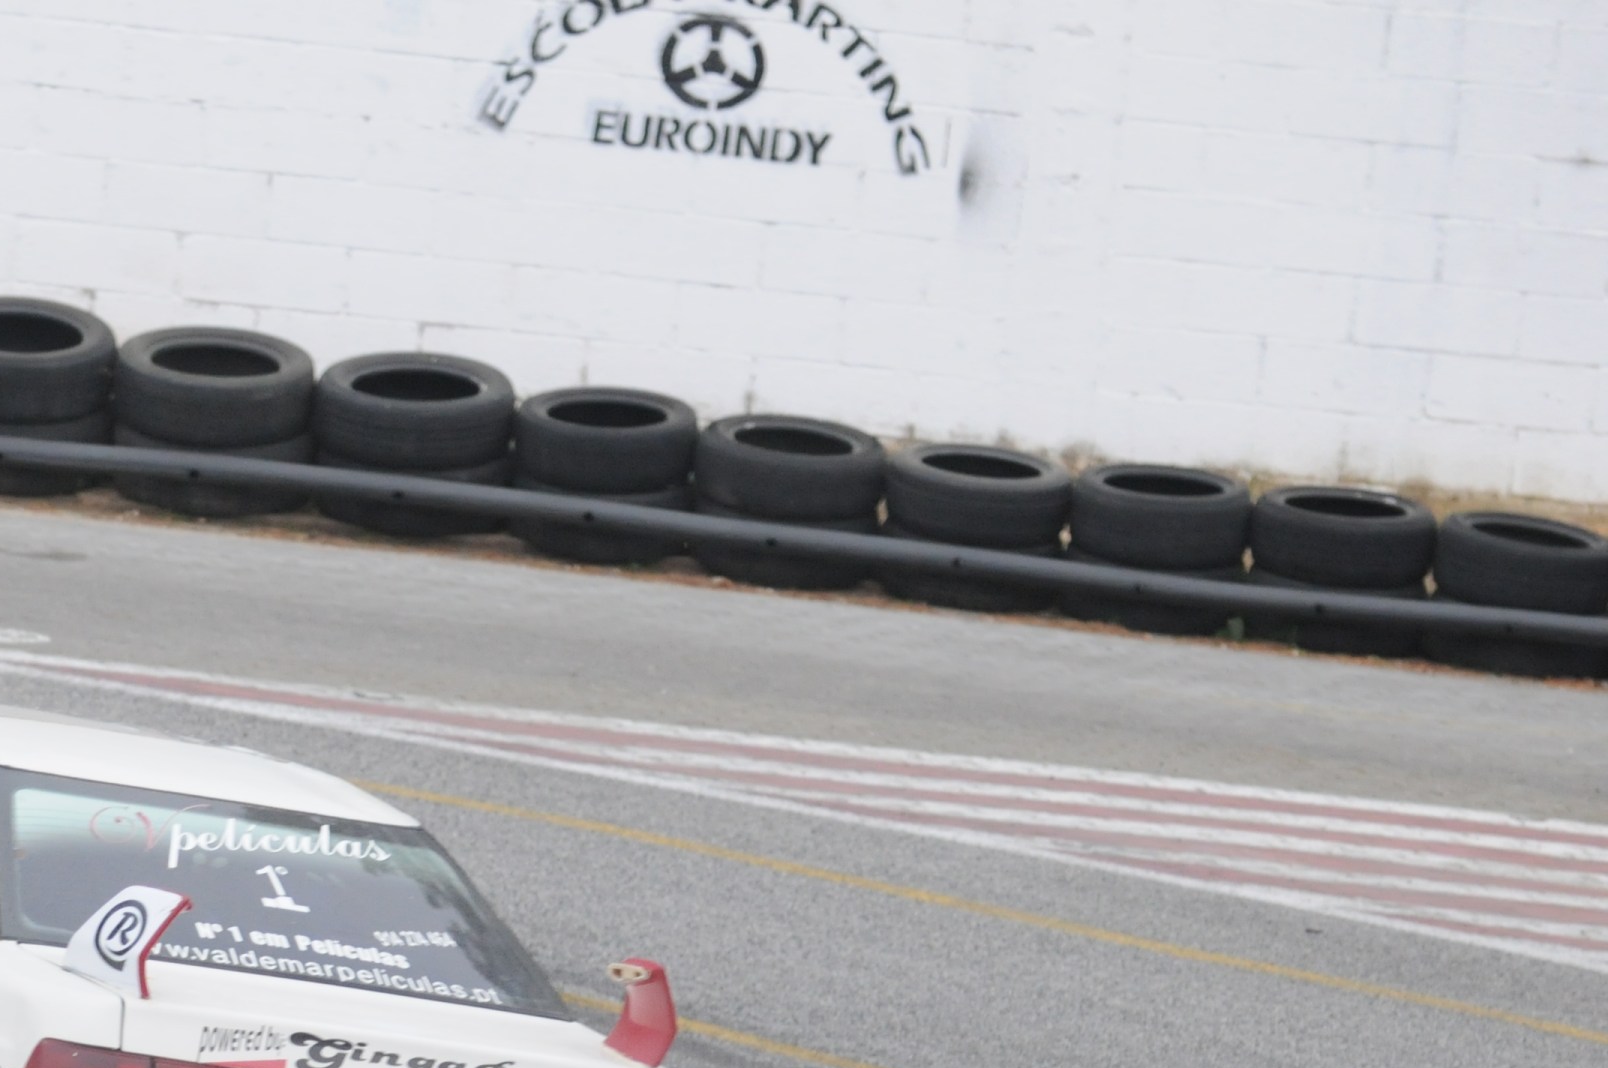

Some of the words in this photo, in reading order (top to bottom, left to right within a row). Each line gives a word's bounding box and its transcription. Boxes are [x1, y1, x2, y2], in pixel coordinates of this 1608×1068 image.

[477, 0, 678, 131] ESCOL
[730, 0, 930, 175] RTING
[591, 109, 832, 166] EUROINDY
[227, 926, 243, 943] 1
[249, 930, 290, 949] em
[196, 1025, 266, 1062] powered
